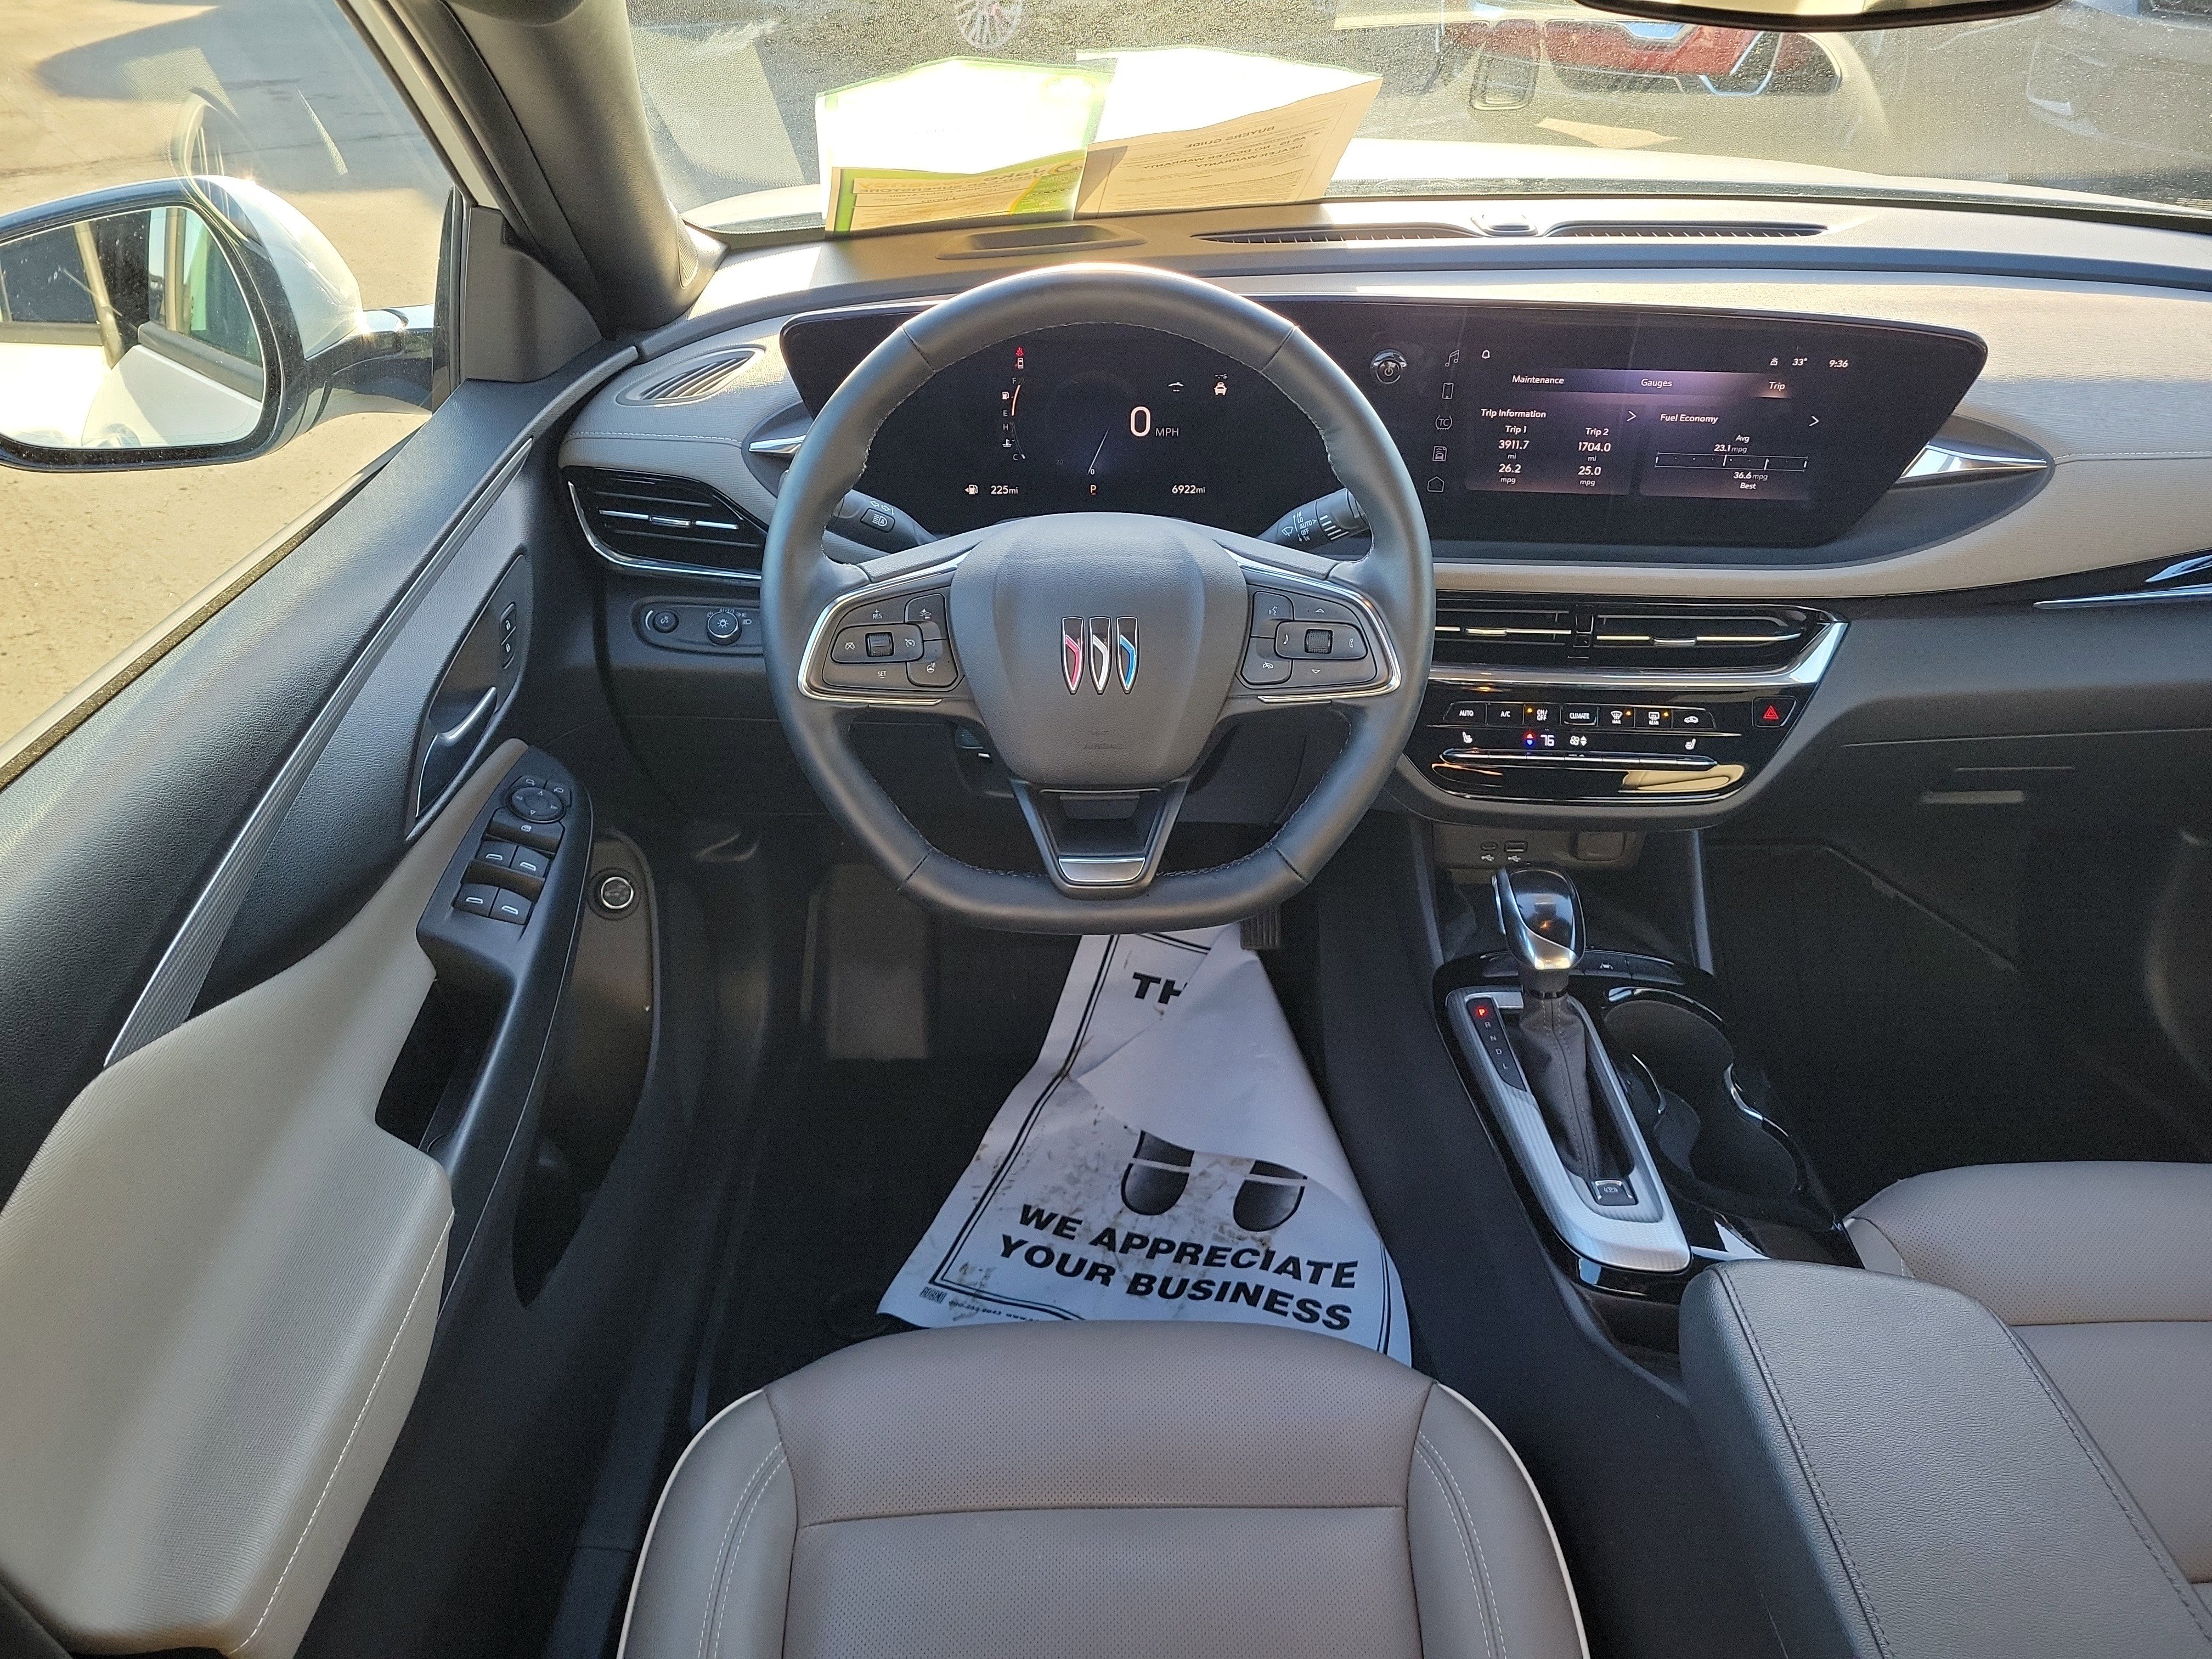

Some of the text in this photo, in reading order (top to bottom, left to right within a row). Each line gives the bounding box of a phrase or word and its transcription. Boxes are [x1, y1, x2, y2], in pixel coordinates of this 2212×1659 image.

[1829, 359, 1848, 368] 9:36
[1512, 375, 1785, 391] Maintenance Gauges Trip
[1481, 408, 1547, 418] Trip Information
[1130, 406, 1180, 437] 0 MPH
[1660, 414, 1718, 425] Fuel Economy
[1505, 425, 1527, 435] Trip 1
[1585, 427, 1602, 437] Trip
[1735, 435, 1750, 443] Avg
[1498, 439, 1530, 450] 3911.7
[1578, 442, 1611, 452] 1704.0
[1713, 444, 1747, 454] 23.1 mpg
[1498, 464, 1521, 473] 26.2
[1578, 466, 1601, 476] 25.0
[1500, 477, 1516, 485] mpg
[1752, 473, 1768, 481] mpg
[1579, 479, 1595, 487] mpg
[1090, 484, 1097, 495] P
[1300, 520, 1312, 529] AUTO
[1540, 734, 1555, 747] 76
[1019, 1204, 1358, 1289] WE APPRECIATE
[1000, 1234, 1353, 1330] YOUR BUSINESS
